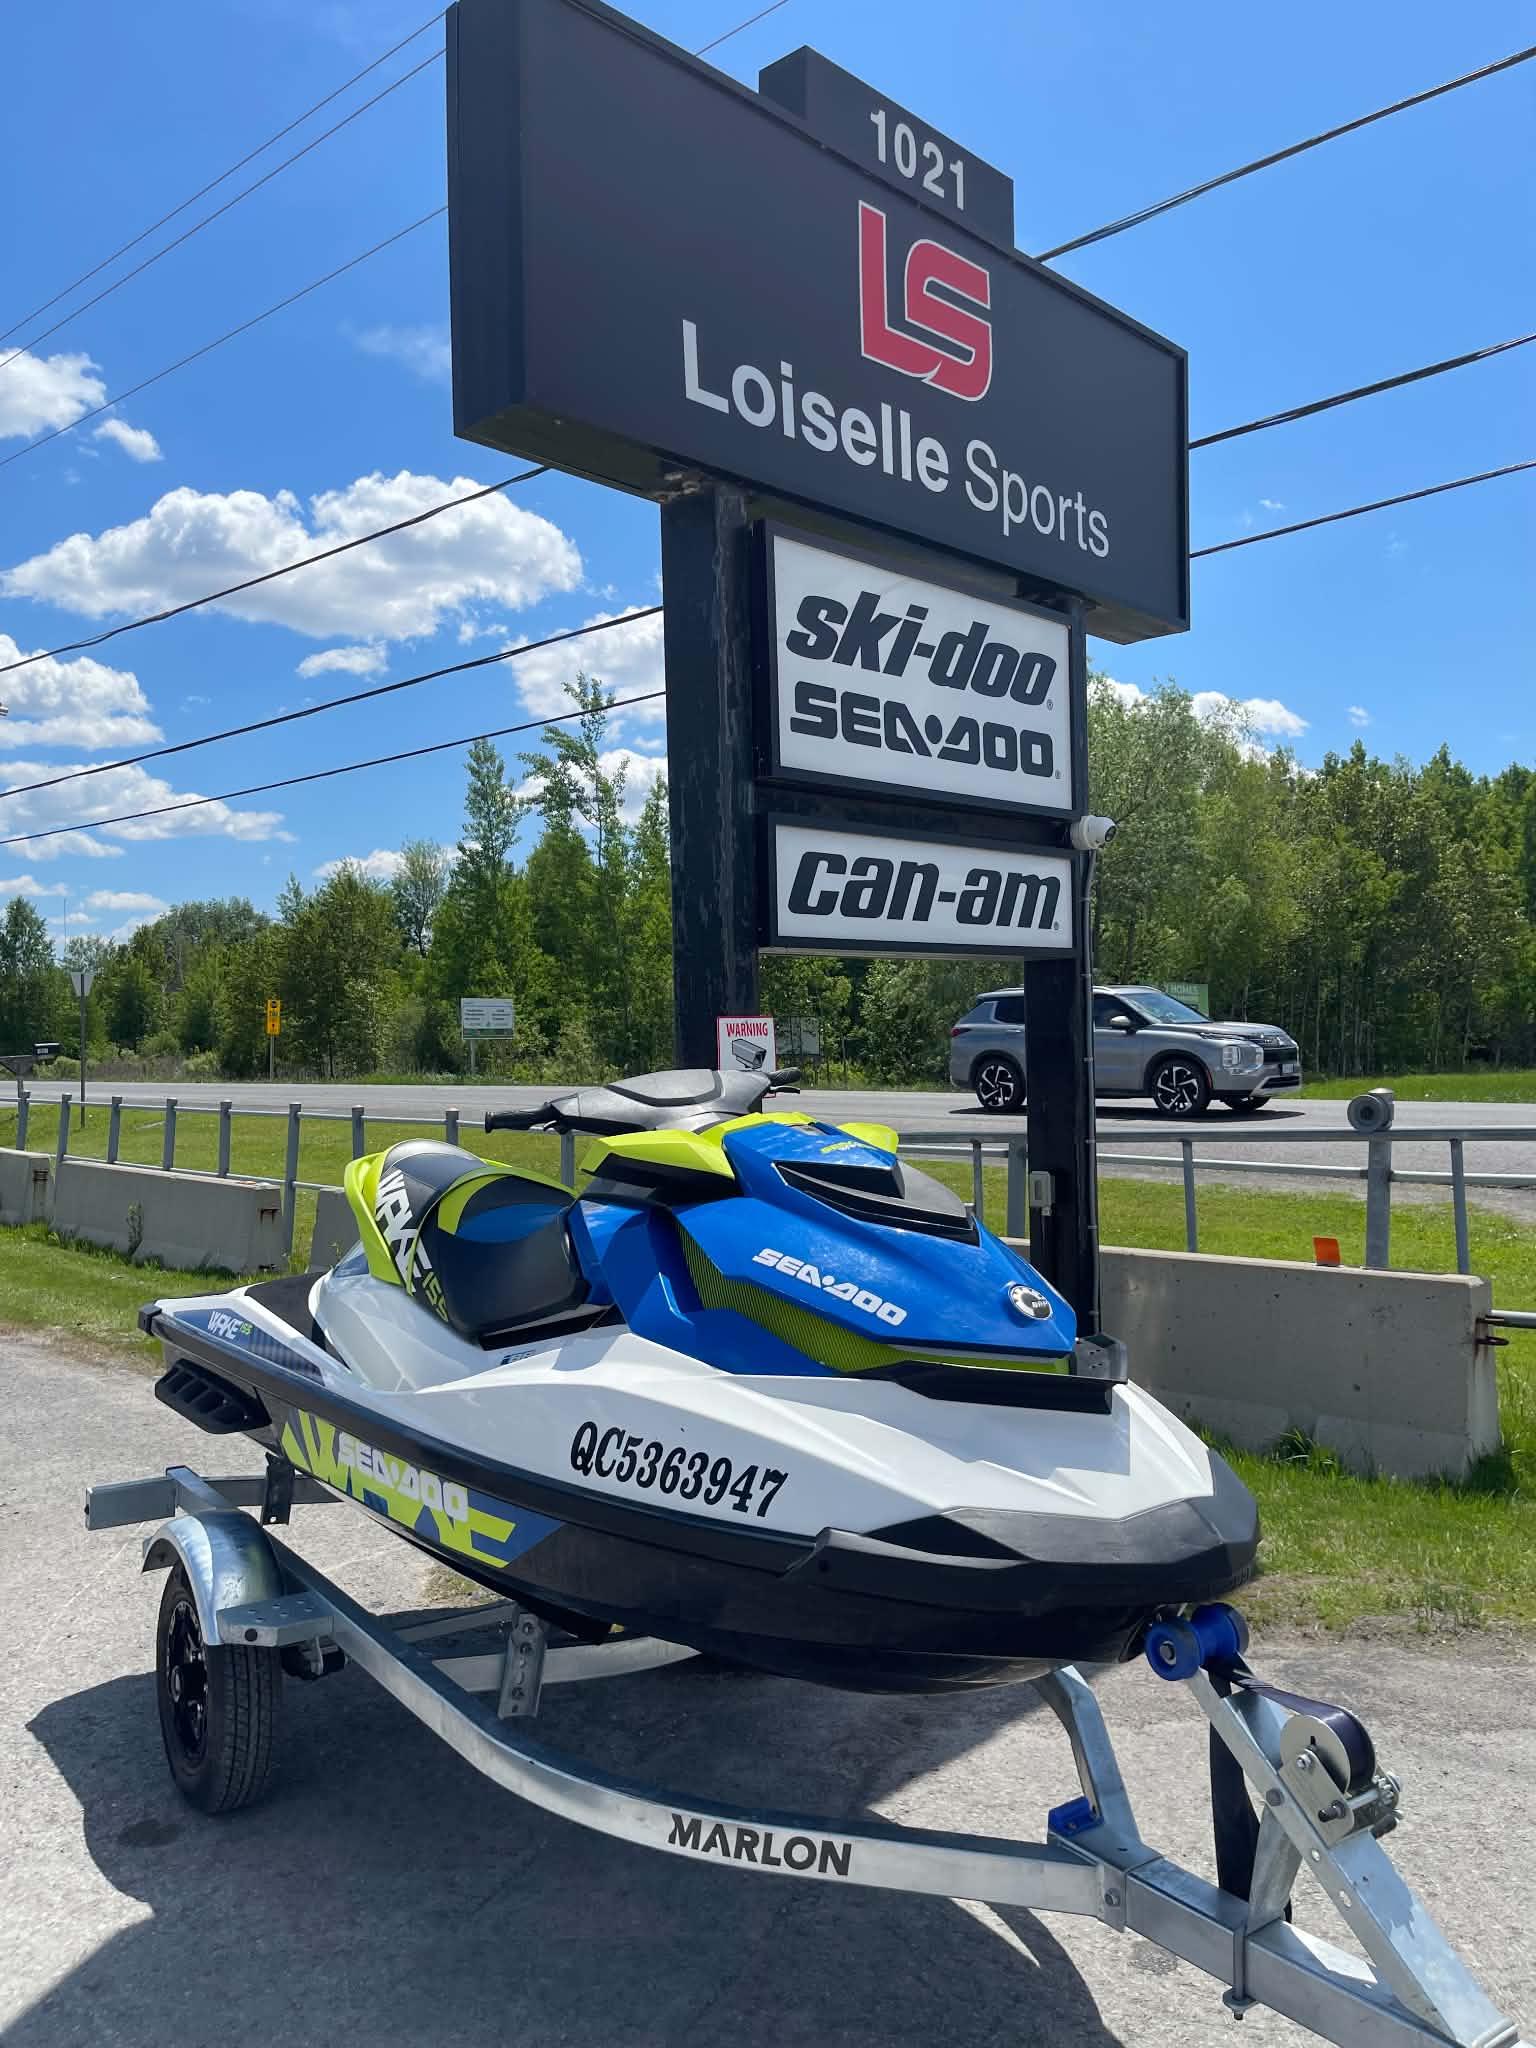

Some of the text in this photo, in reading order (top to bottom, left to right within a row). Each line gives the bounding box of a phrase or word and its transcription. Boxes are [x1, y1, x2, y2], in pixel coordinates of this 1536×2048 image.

[870, 110, 965, 210] 1021
[858, 200, 992, 402] LS
[682, 319, 1110, 558] Loiselle Sports
[786, 591, 1057, 706] ski-doo
[788, 851, 1062, 930] can-am
[726, 1022, 769, 1037] WARNING
[570, 1421, 789, 1518] QC5363947
[667, 1813, 852, 1876] MARLON
